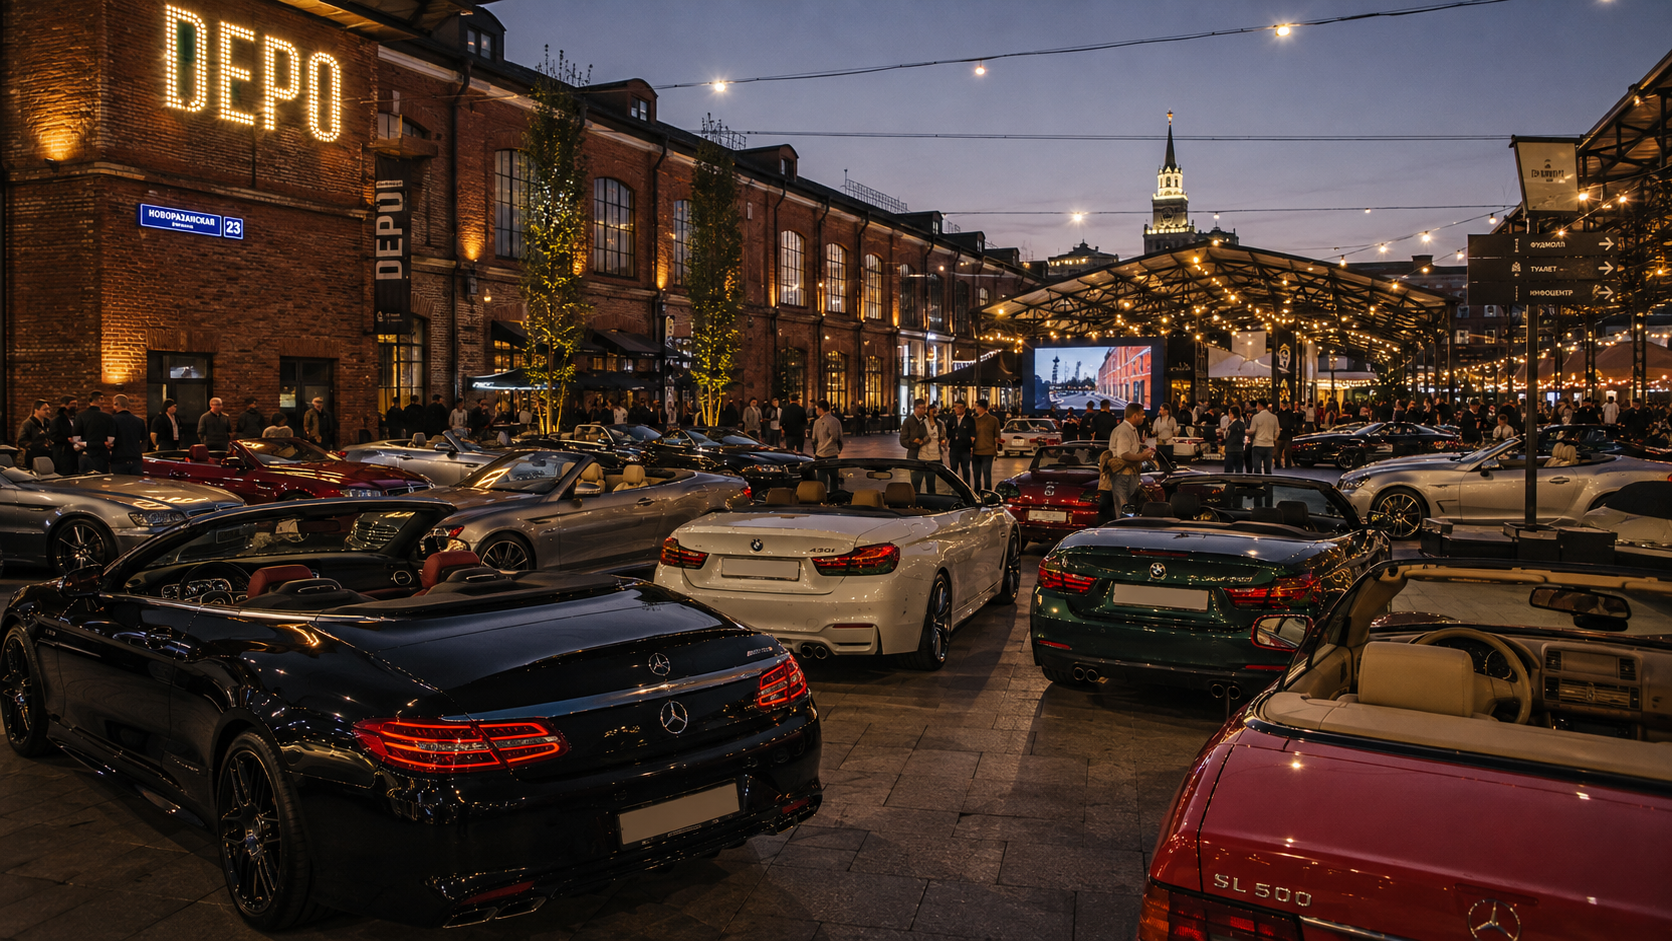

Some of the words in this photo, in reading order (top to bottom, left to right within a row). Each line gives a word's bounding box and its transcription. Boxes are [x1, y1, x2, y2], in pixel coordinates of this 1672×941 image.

[165, 3, 342, 143] DEPO
[226, 220, 241, 235] 23
[1530, 265, 1558, 273] ТУАЛЕТ
[1213, 873, 1247, 894] SL
[1254, 882, 1312, 907] 500
